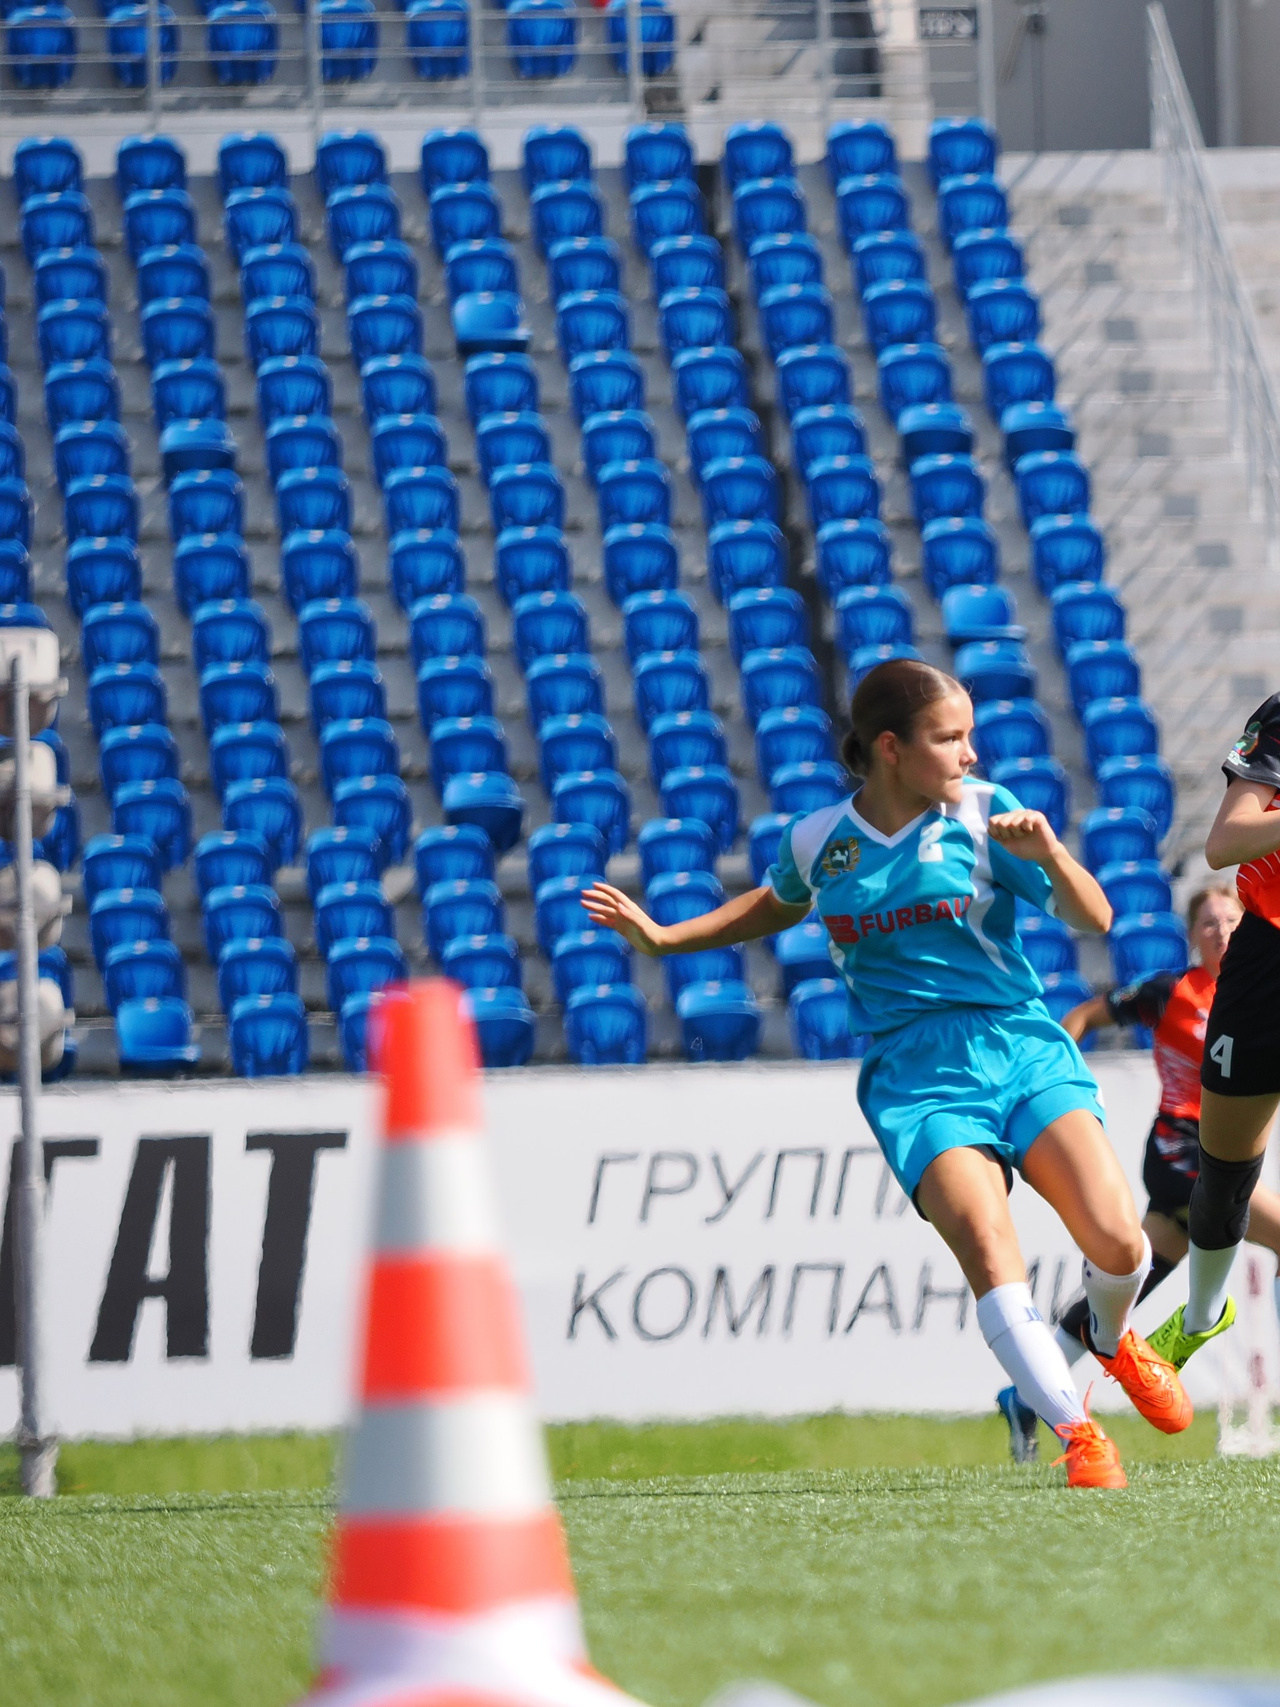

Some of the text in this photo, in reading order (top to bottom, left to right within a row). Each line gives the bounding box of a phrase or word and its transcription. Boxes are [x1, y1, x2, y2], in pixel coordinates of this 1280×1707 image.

[918, 821, 944, 863] 2
[859, 895, 972, 938] FURBAU
[1210, 1034, 1234, 1079] 4
[585, 1146, 910, 1225] ГРУПП
